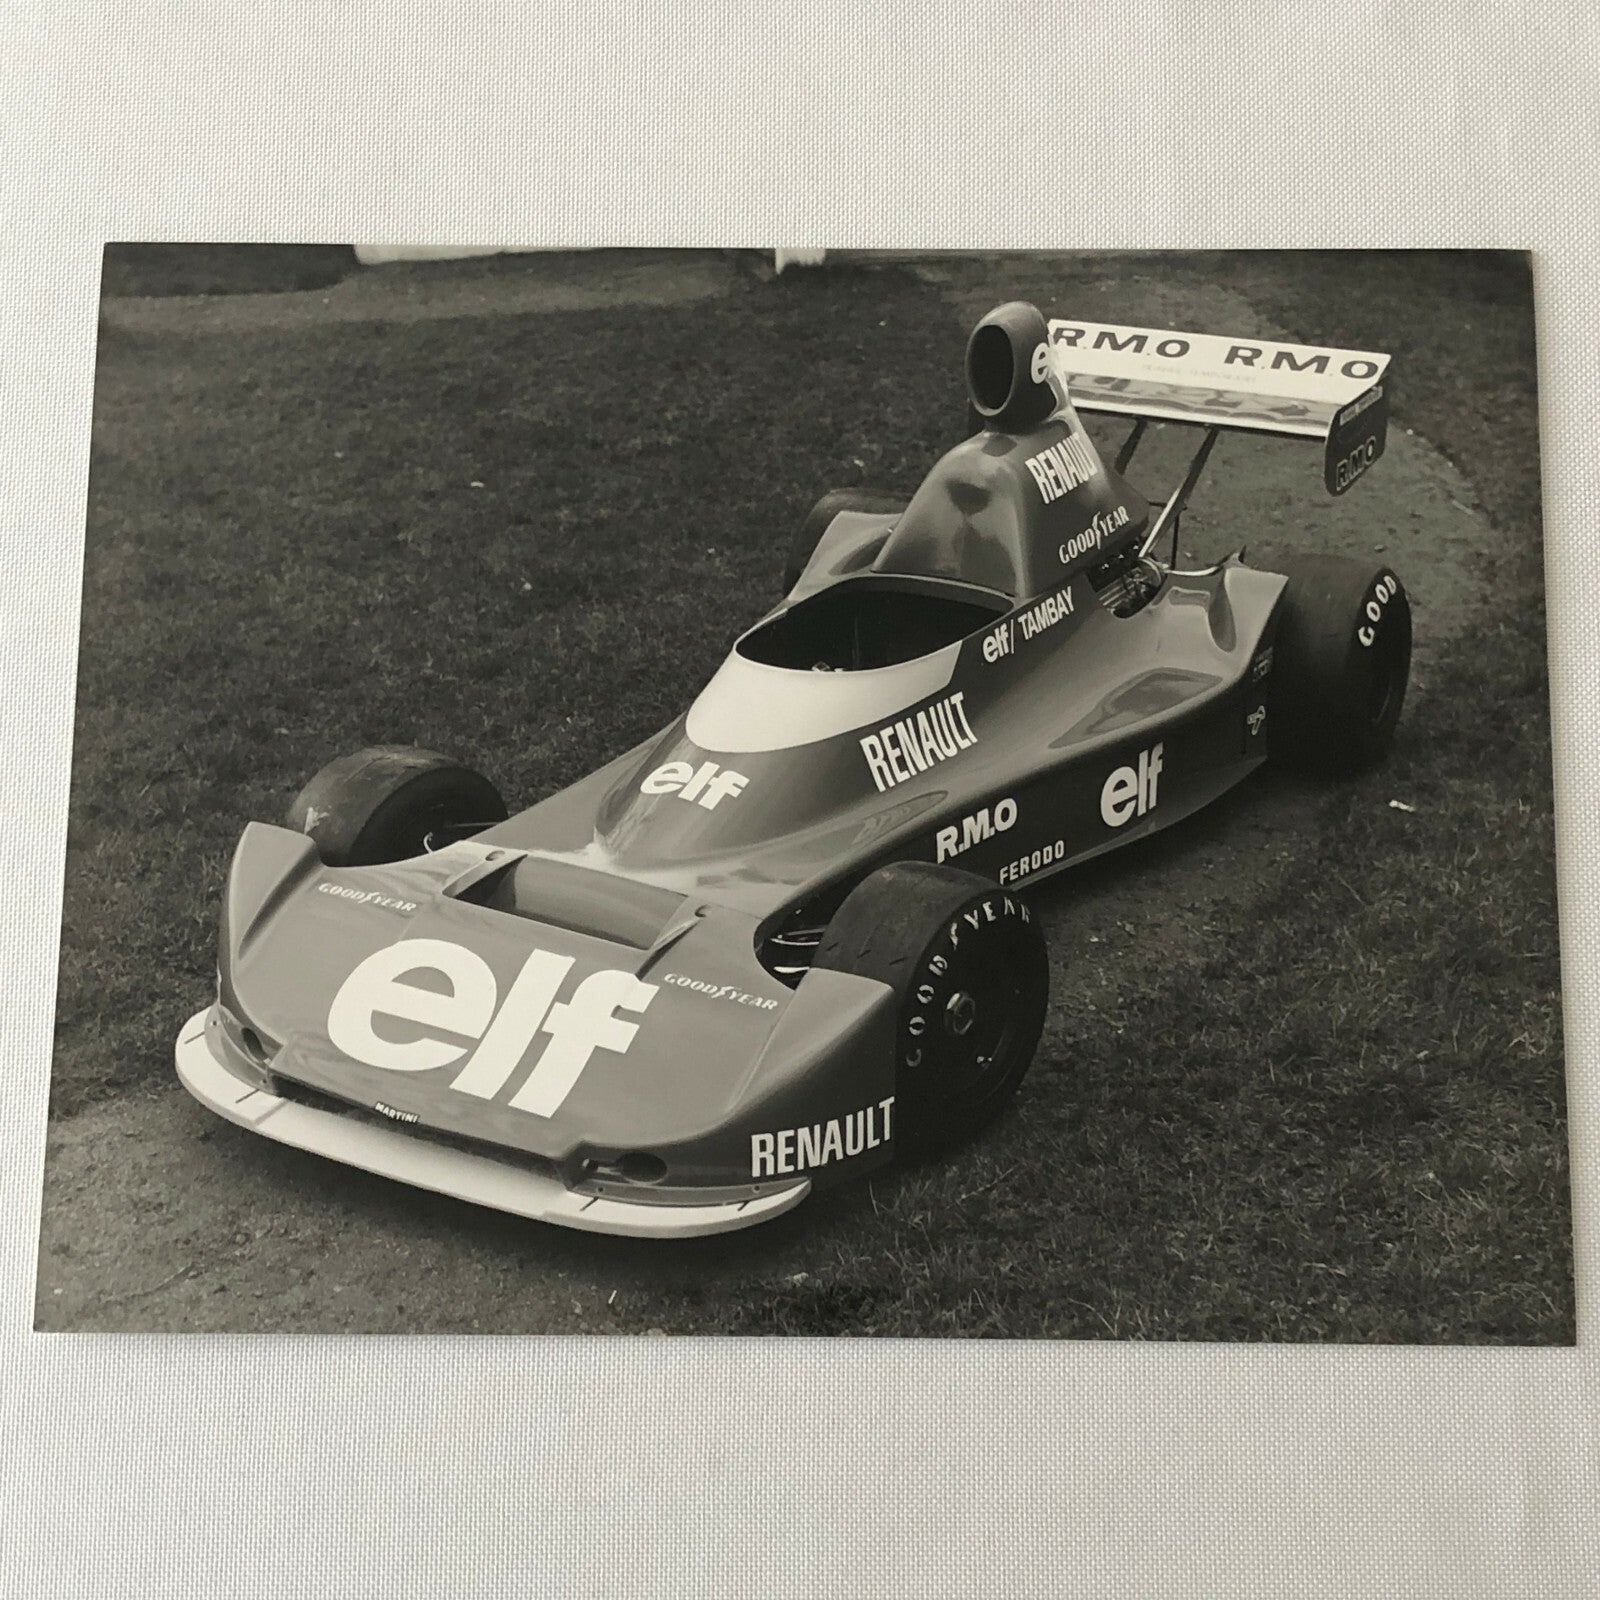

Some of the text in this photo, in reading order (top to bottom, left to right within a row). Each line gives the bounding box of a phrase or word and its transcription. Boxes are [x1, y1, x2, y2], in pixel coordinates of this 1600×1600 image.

[1224, 345, 1379, 380] R.M.O
[1058, 505, 1130, 564] GOODYEAR
[1017, 586, 1076, 642] TAMBAY
[859, 691, 979, 793] RENAULT
[639, 760, 750, 811] elf
[1100, 742, 1165, 828] elf
[936, 797, 1019, 864] R.M.O
[998, 840, 1066, 886] FERODO
[318, 881, 419, 914] GOODYEAR
[662, 971, 780, 1013] GOODYEAR
[326, 937, 660, 1118] elf
[374, 1101, 418, 1124] MARTINI
[751, 1096, 896, 1178] RENAULT
